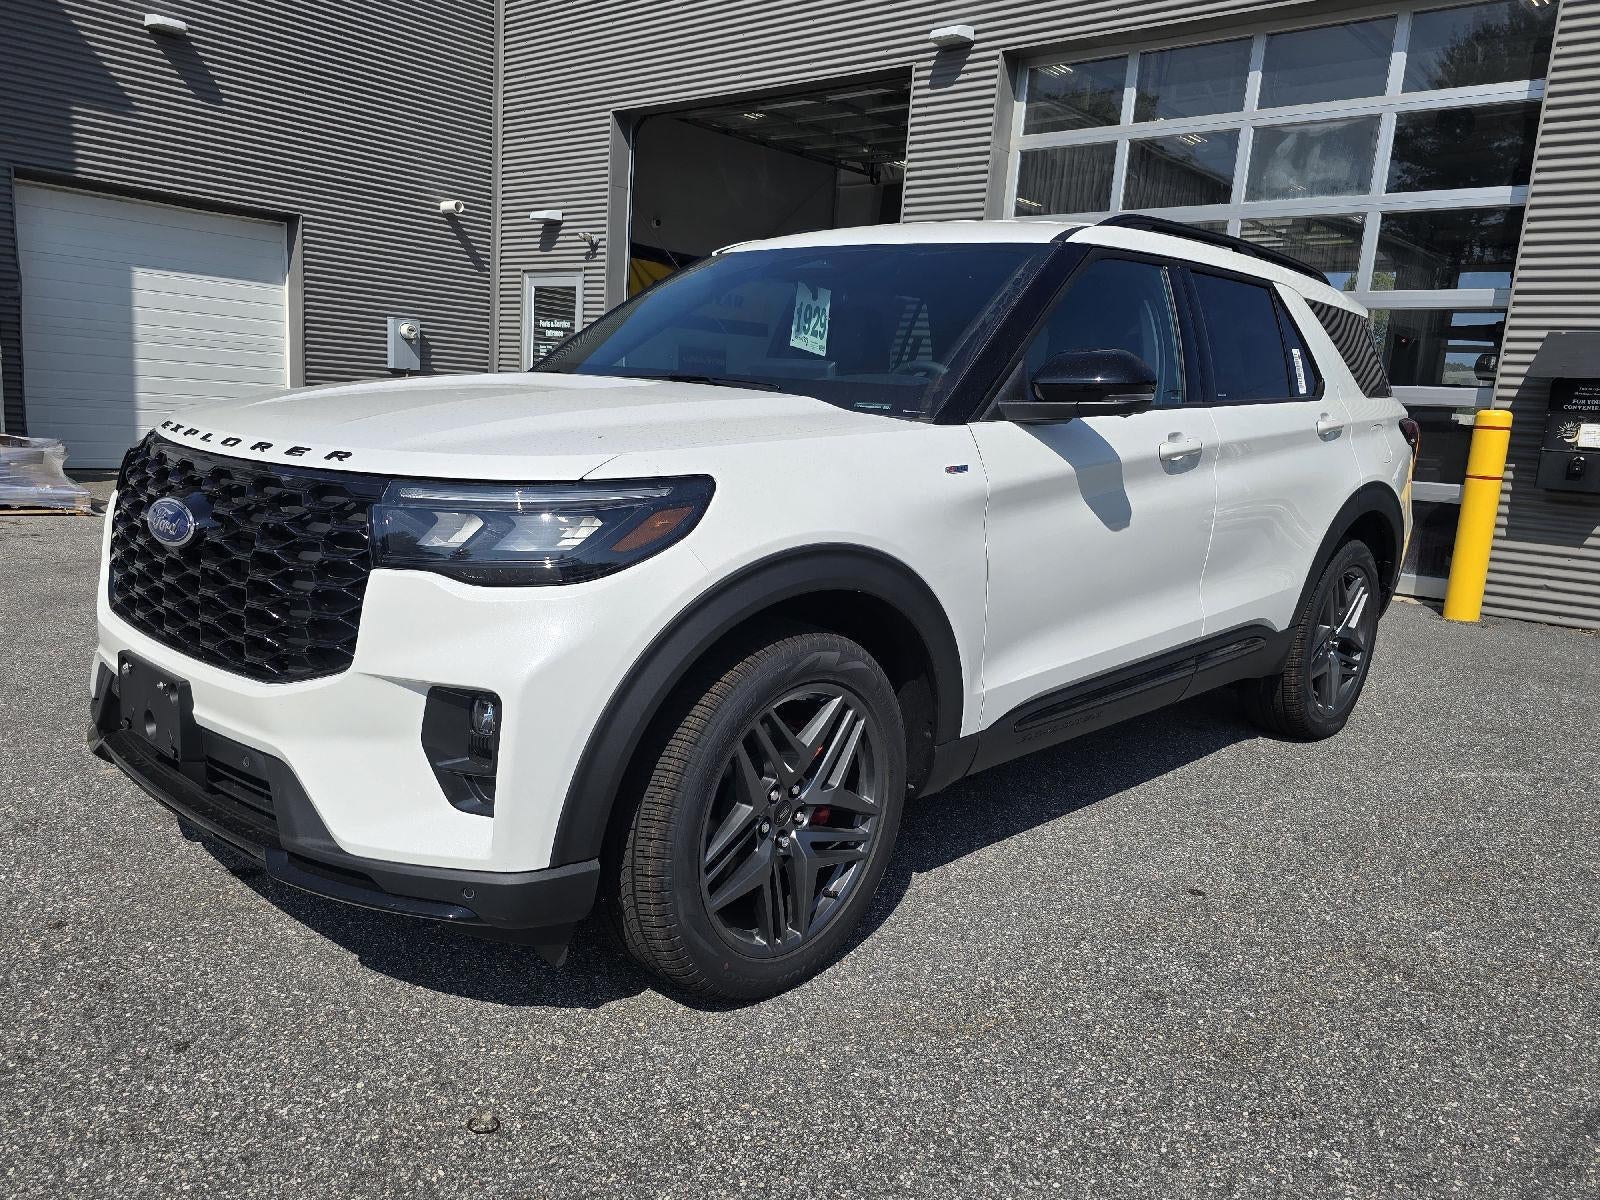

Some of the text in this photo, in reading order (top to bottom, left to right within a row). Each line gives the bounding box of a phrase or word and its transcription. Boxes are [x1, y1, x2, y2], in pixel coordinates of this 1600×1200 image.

[795, 302, 827, 341] 1929
[161, 420, 353, 462] EXPLORER
[152, 506, 181, 536] Ford
